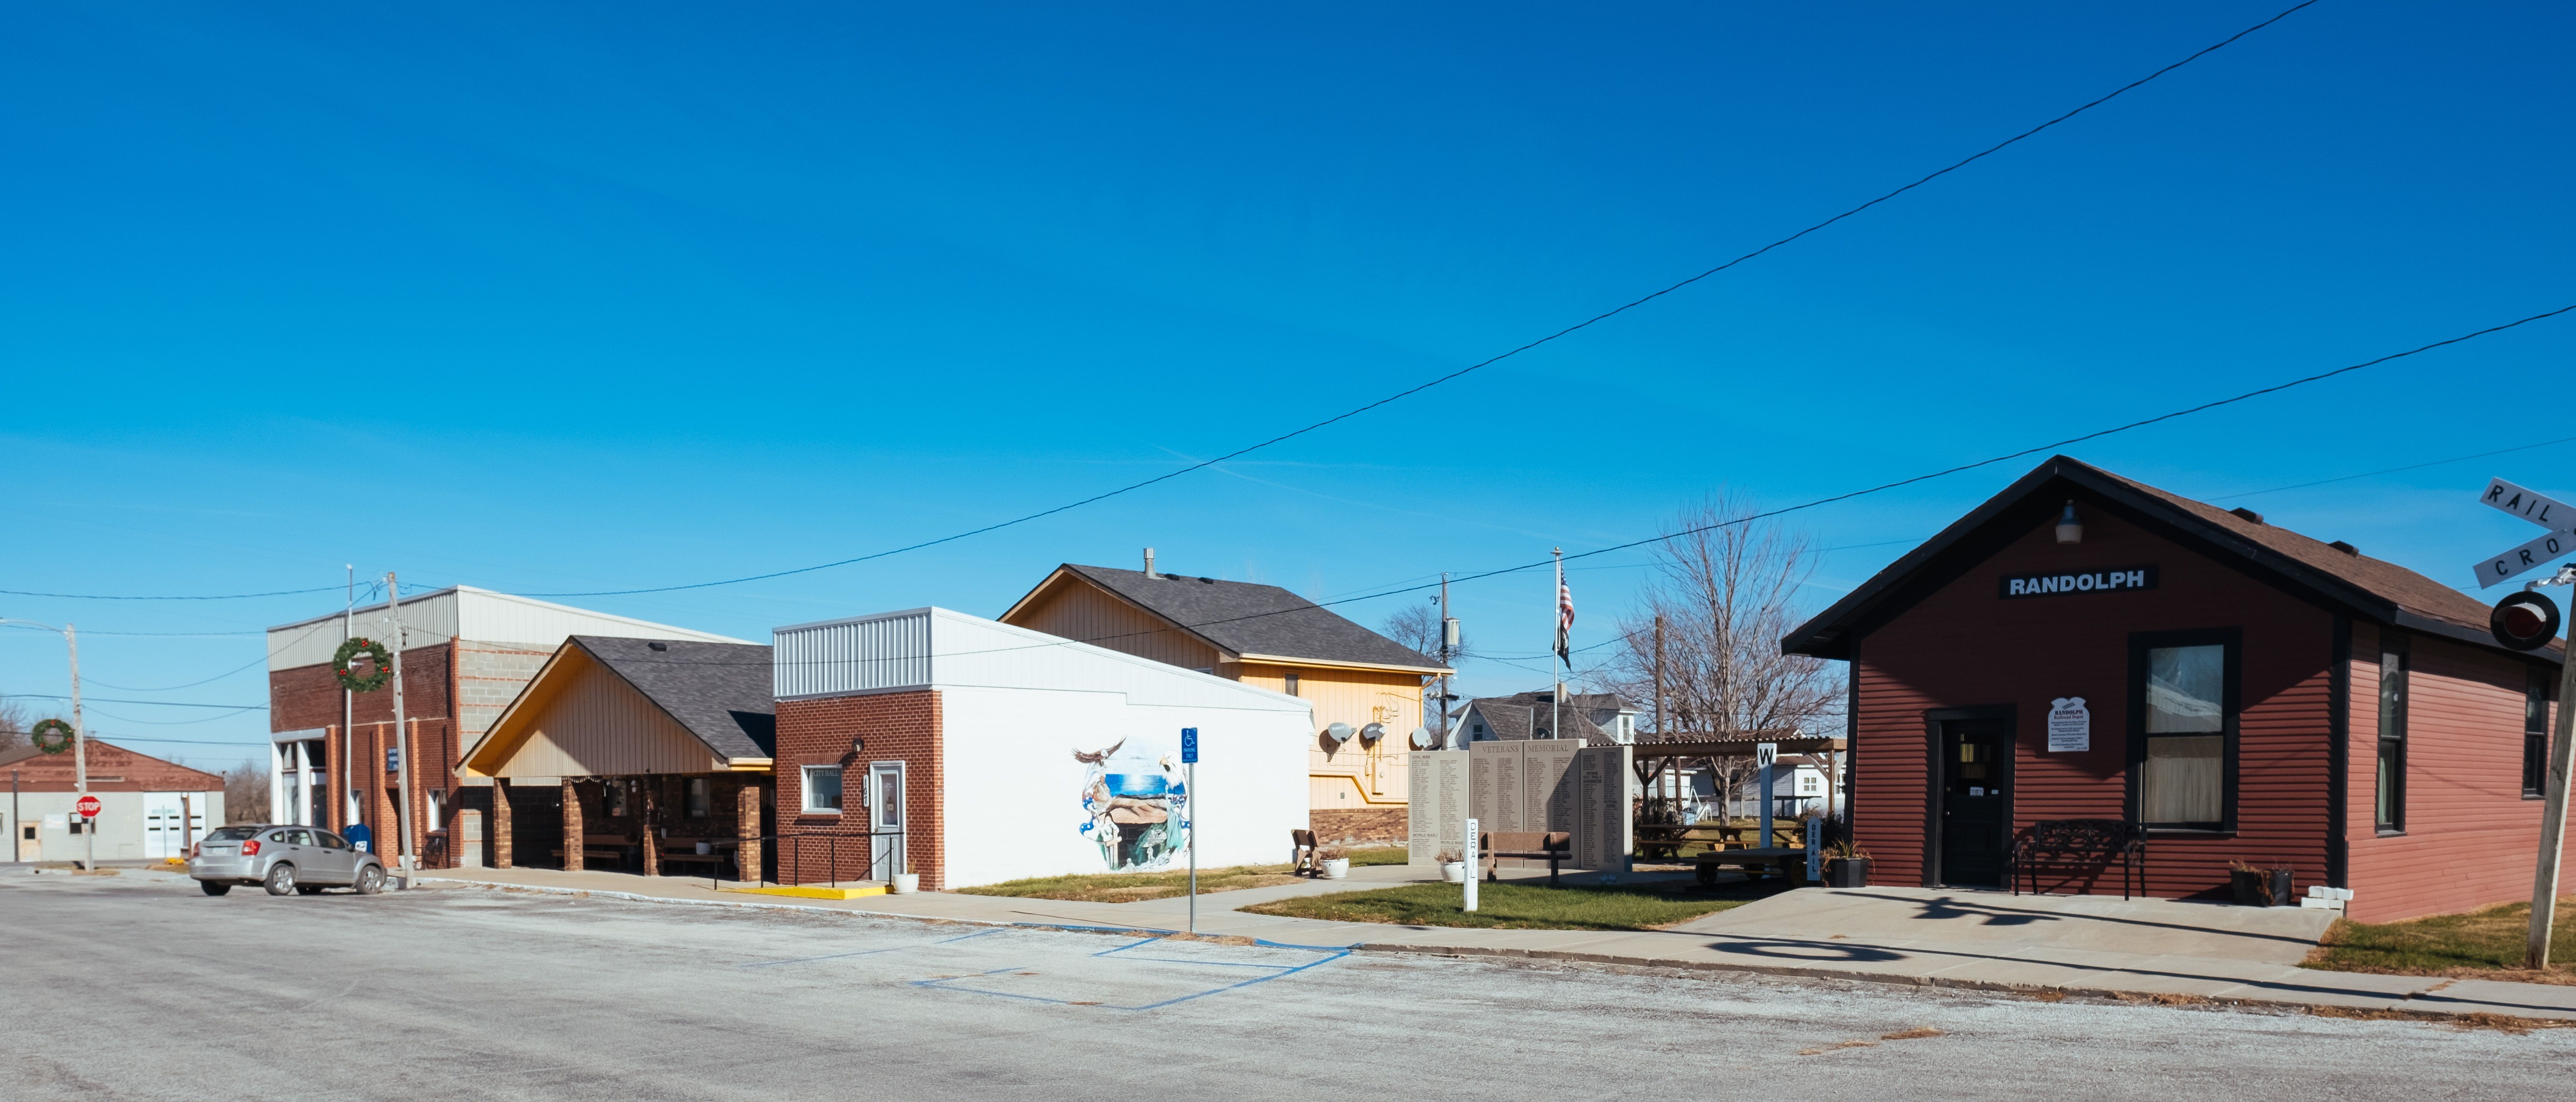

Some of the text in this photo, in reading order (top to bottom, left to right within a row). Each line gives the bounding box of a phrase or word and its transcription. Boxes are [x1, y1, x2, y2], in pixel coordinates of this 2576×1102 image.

[2488, 484, 2550, 522] RAIL
[2495, 528, 2576, 576] CRO
[2010, 570, 2144, 595] RANDOLPH
[1759, 748, 1774, 765] W
[78, 802, 100, 811] STOP
